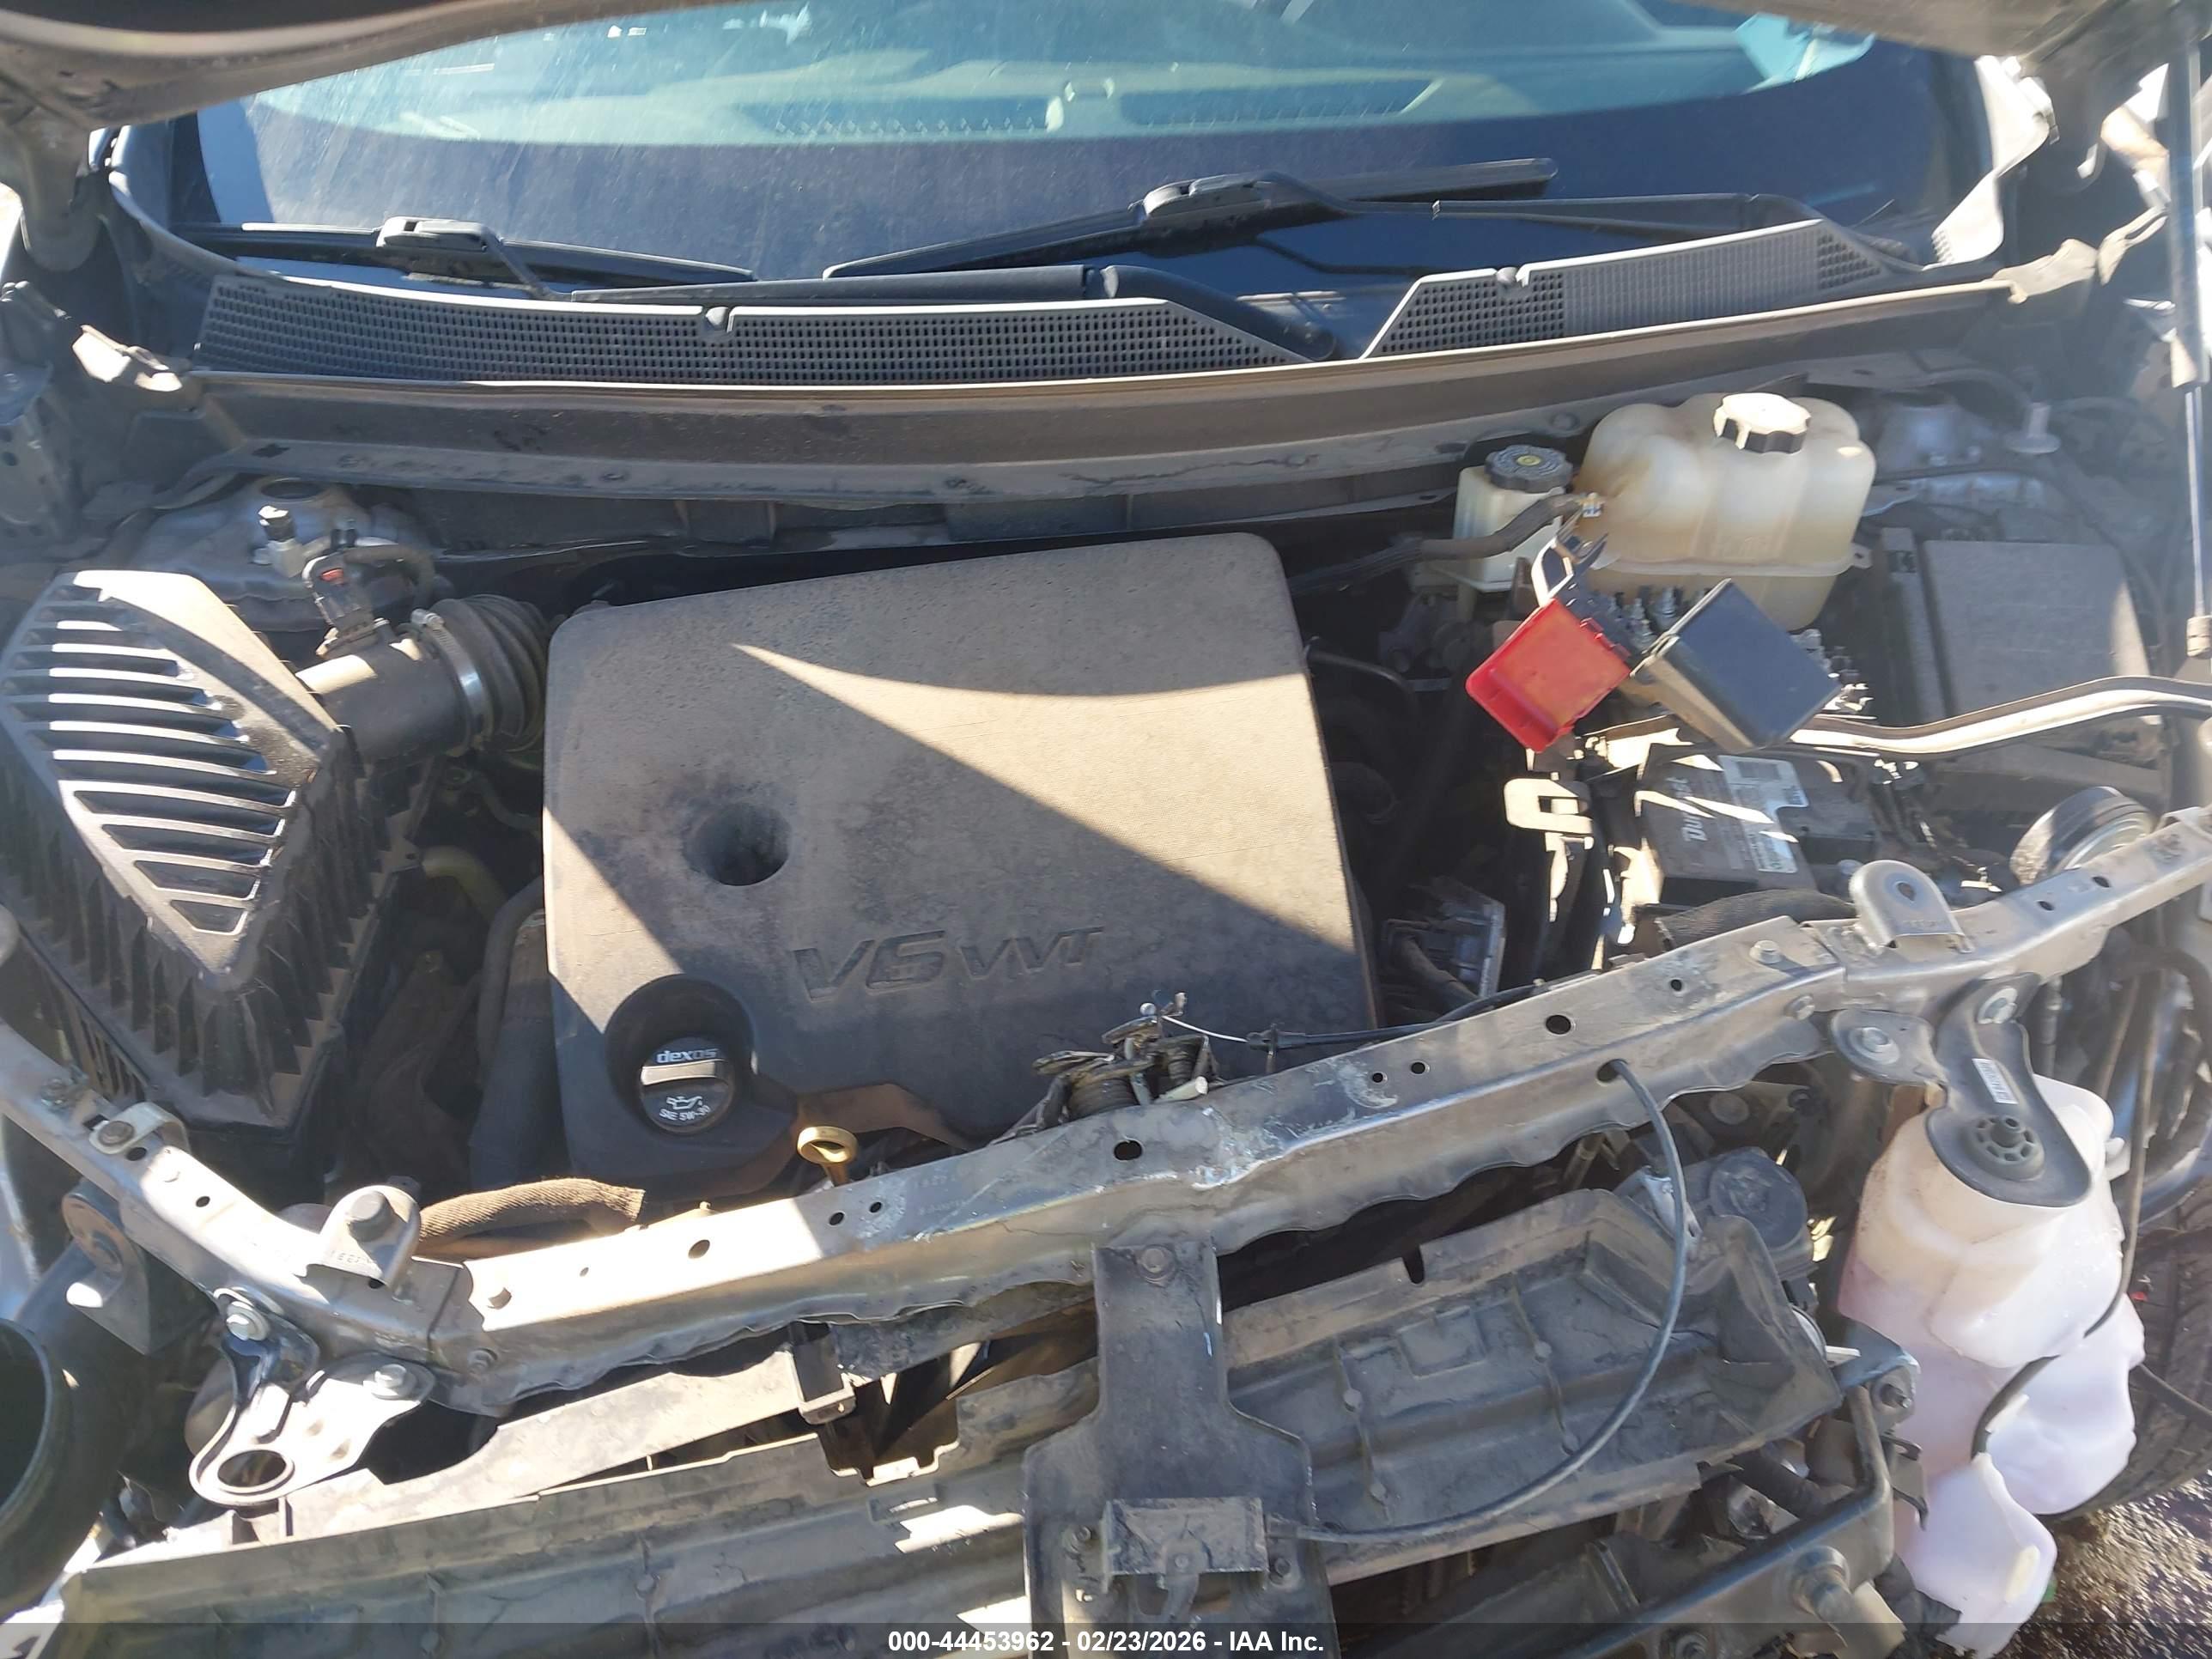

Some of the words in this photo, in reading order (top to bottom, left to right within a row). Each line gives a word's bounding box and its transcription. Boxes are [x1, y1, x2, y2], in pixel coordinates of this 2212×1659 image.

[1664, 776, 1709, 842] Durast
[792, 929, 945, 1003] V6
[957, 926, 1105, 981] VVT
[656, 1048, 719, 1064] dexos
